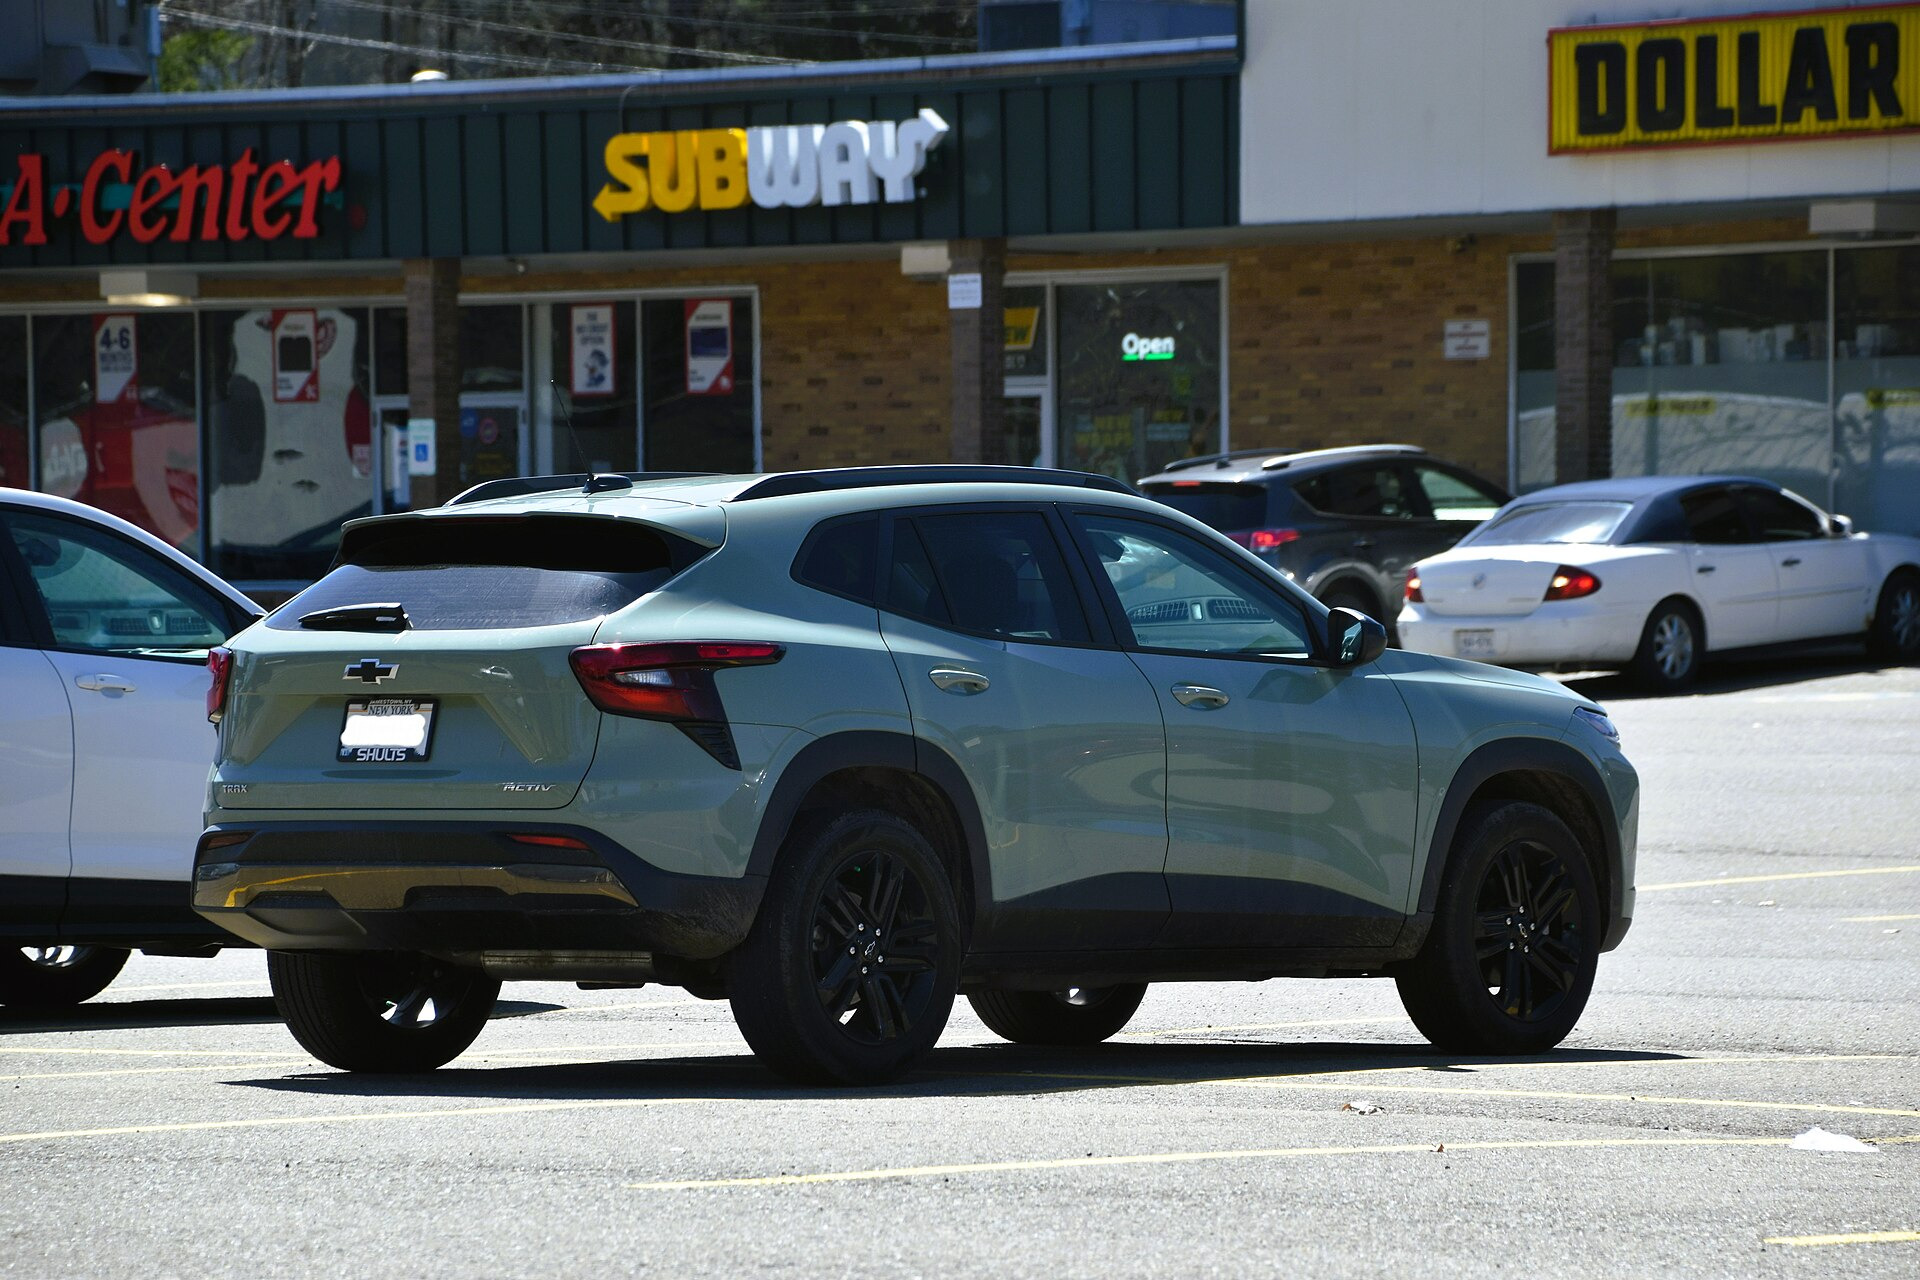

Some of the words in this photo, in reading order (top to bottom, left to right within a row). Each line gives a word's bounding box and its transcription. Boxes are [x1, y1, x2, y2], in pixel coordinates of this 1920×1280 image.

[1575, 21, 1904, 136] DOLLAR
[592, 107, 950, 223] SUBWAY
[1121, 332, 1175, 361] Open
[368, 705, 389, 715] NEW
[390, 705, 414, 715] YORK
[356, 748, 406, 761] SHULTS
[222, 784, 248, 793] TRAX
[502, 784, 557, 792] ACTIV
